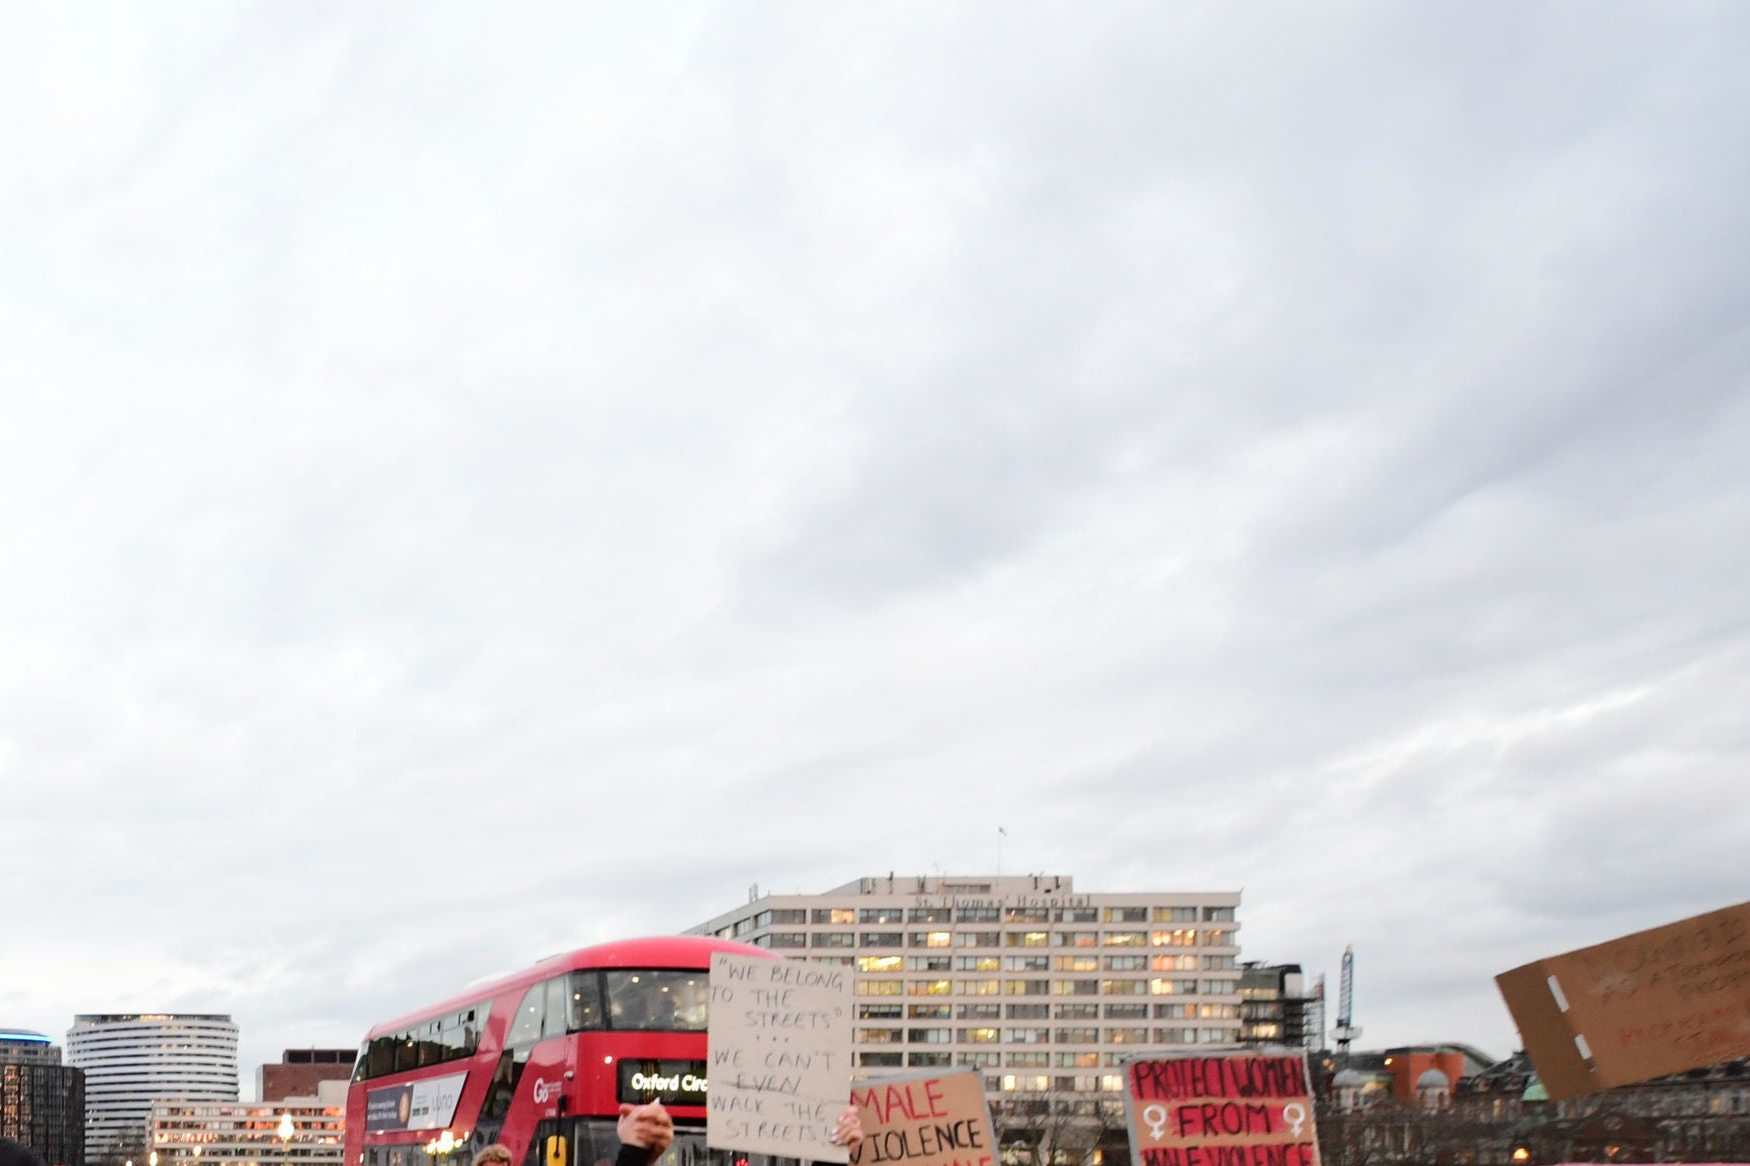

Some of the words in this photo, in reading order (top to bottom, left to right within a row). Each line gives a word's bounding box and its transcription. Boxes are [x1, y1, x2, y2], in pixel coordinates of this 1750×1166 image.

[770, 966, 843, 991] BELONG
[711, 987, 733, 1002] TO
[752, 988, 795, 1008] THE
[714, 1049, 745, 1067] WE
[764, 1052, 836, 1071] CAN'T
[631, 1072, 680, 1092] Oxford
[736, 1073, 802, 1094] EVEN
[1134, 1057, 1226, 1099] PROTECT
[1226, 1055, 1308, 1098] WOMEN
[711, 1096, 764, 1114] WALK
[783, 1101, 827, 1122] THE
[850, 1080, 949, 1126] MALE
[1177, 1102, 1272, 1138] FROM
